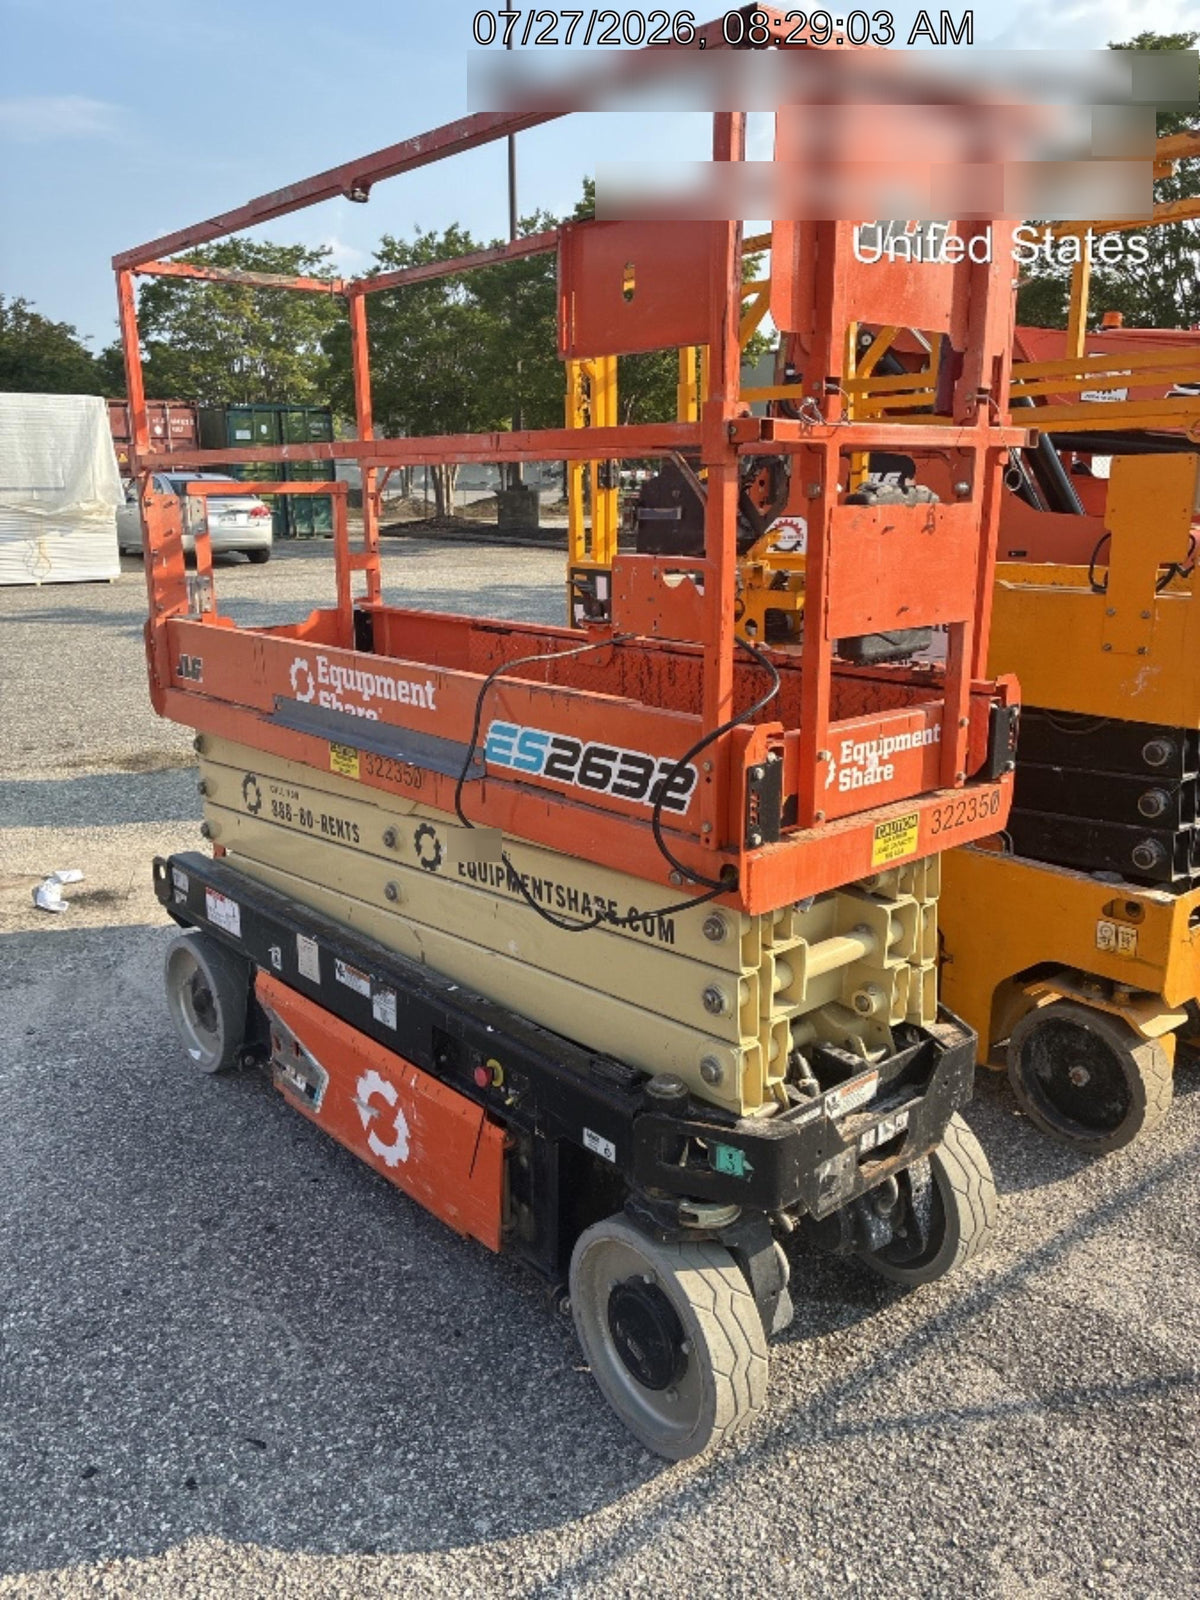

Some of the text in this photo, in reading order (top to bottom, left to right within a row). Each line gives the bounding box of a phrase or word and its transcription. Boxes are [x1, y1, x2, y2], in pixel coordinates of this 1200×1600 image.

[315, 655, 437, 711] Equipment
[840, 722, 942, 765] Equipment
[484, 718, 698, 816] ES2632
[838, 763, 895, 793] Share
[930, 789, 1001, 835] 322350
